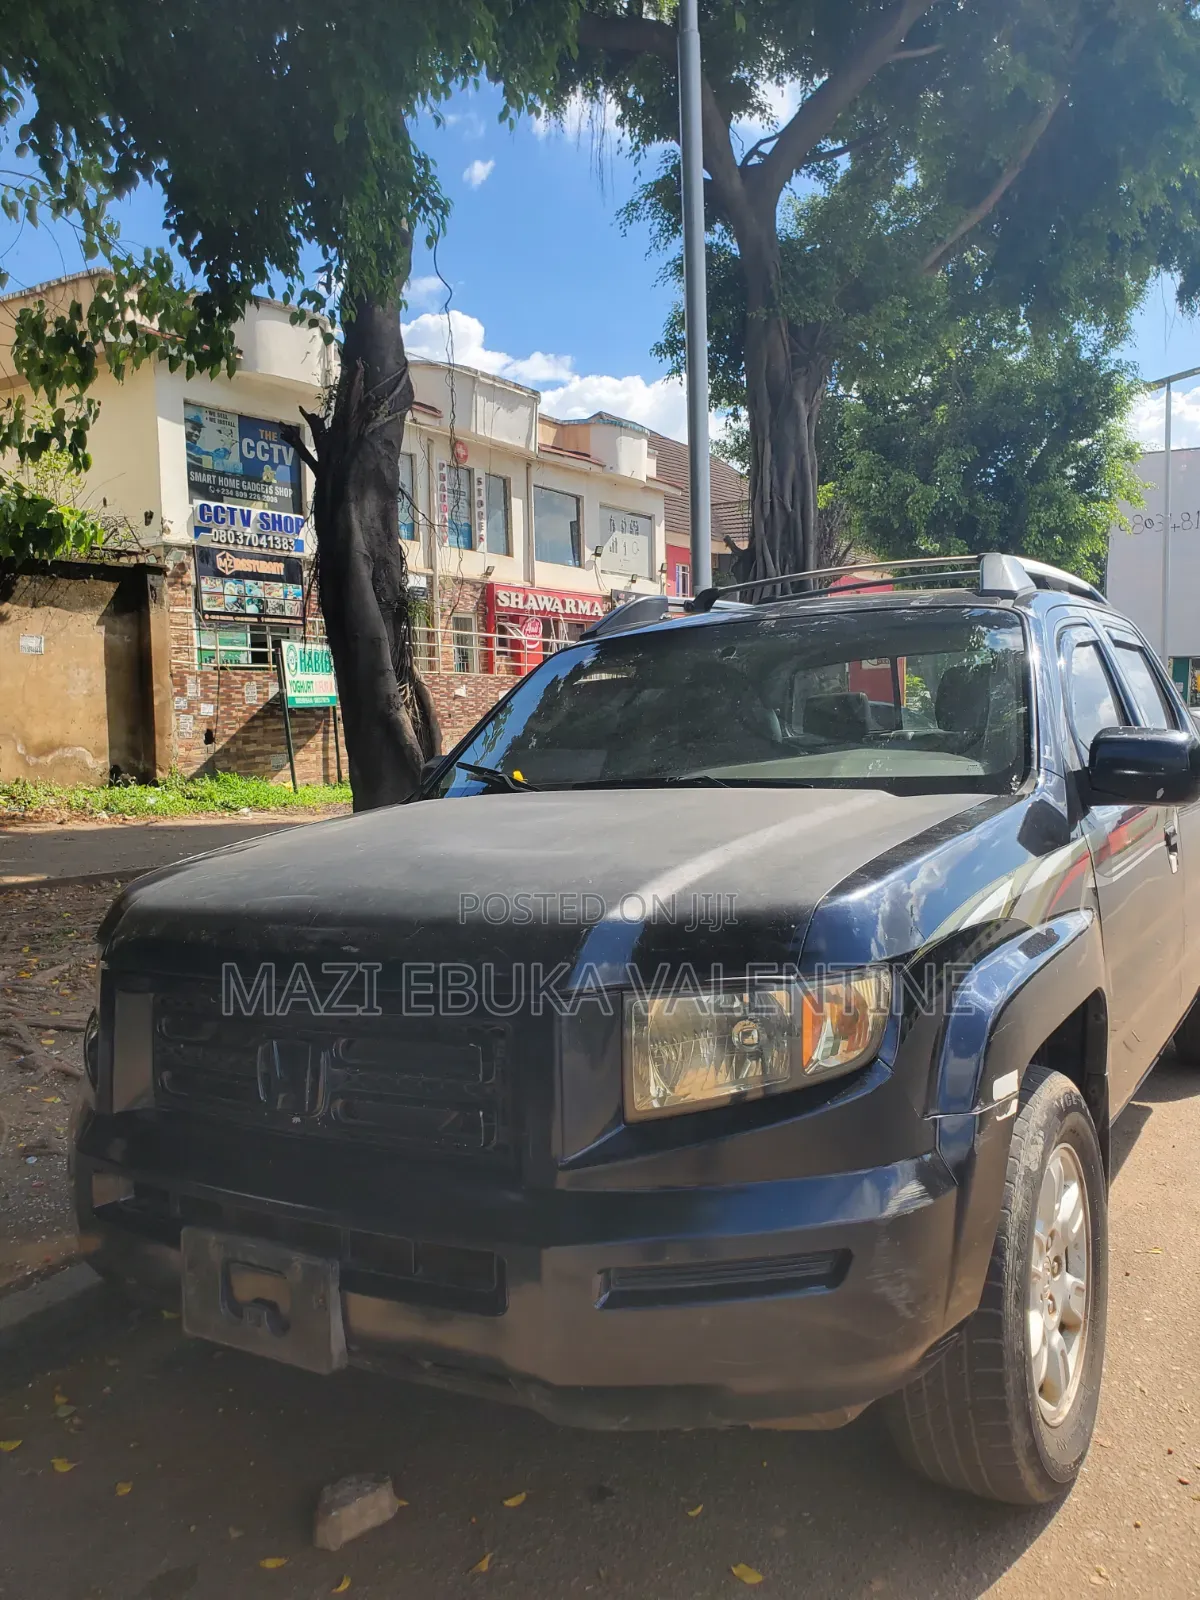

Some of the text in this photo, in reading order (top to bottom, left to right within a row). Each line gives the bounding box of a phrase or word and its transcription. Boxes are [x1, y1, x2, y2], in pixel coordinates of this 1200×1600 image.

[259, 428, 278, 442] THE
[241, 437, 295, 467] CCTV
[189, 470, 293, 499] SMART HOME GADGETS SHOP
[199, 503, 305, 537] CCTV SHOP
[476, 476, 485, 543] STORES
[212, 528, 296, 551] 08037041383
[496, 589, 604, 617] SHAWARMA
[288, 680, 314, 694] YOGHURT
